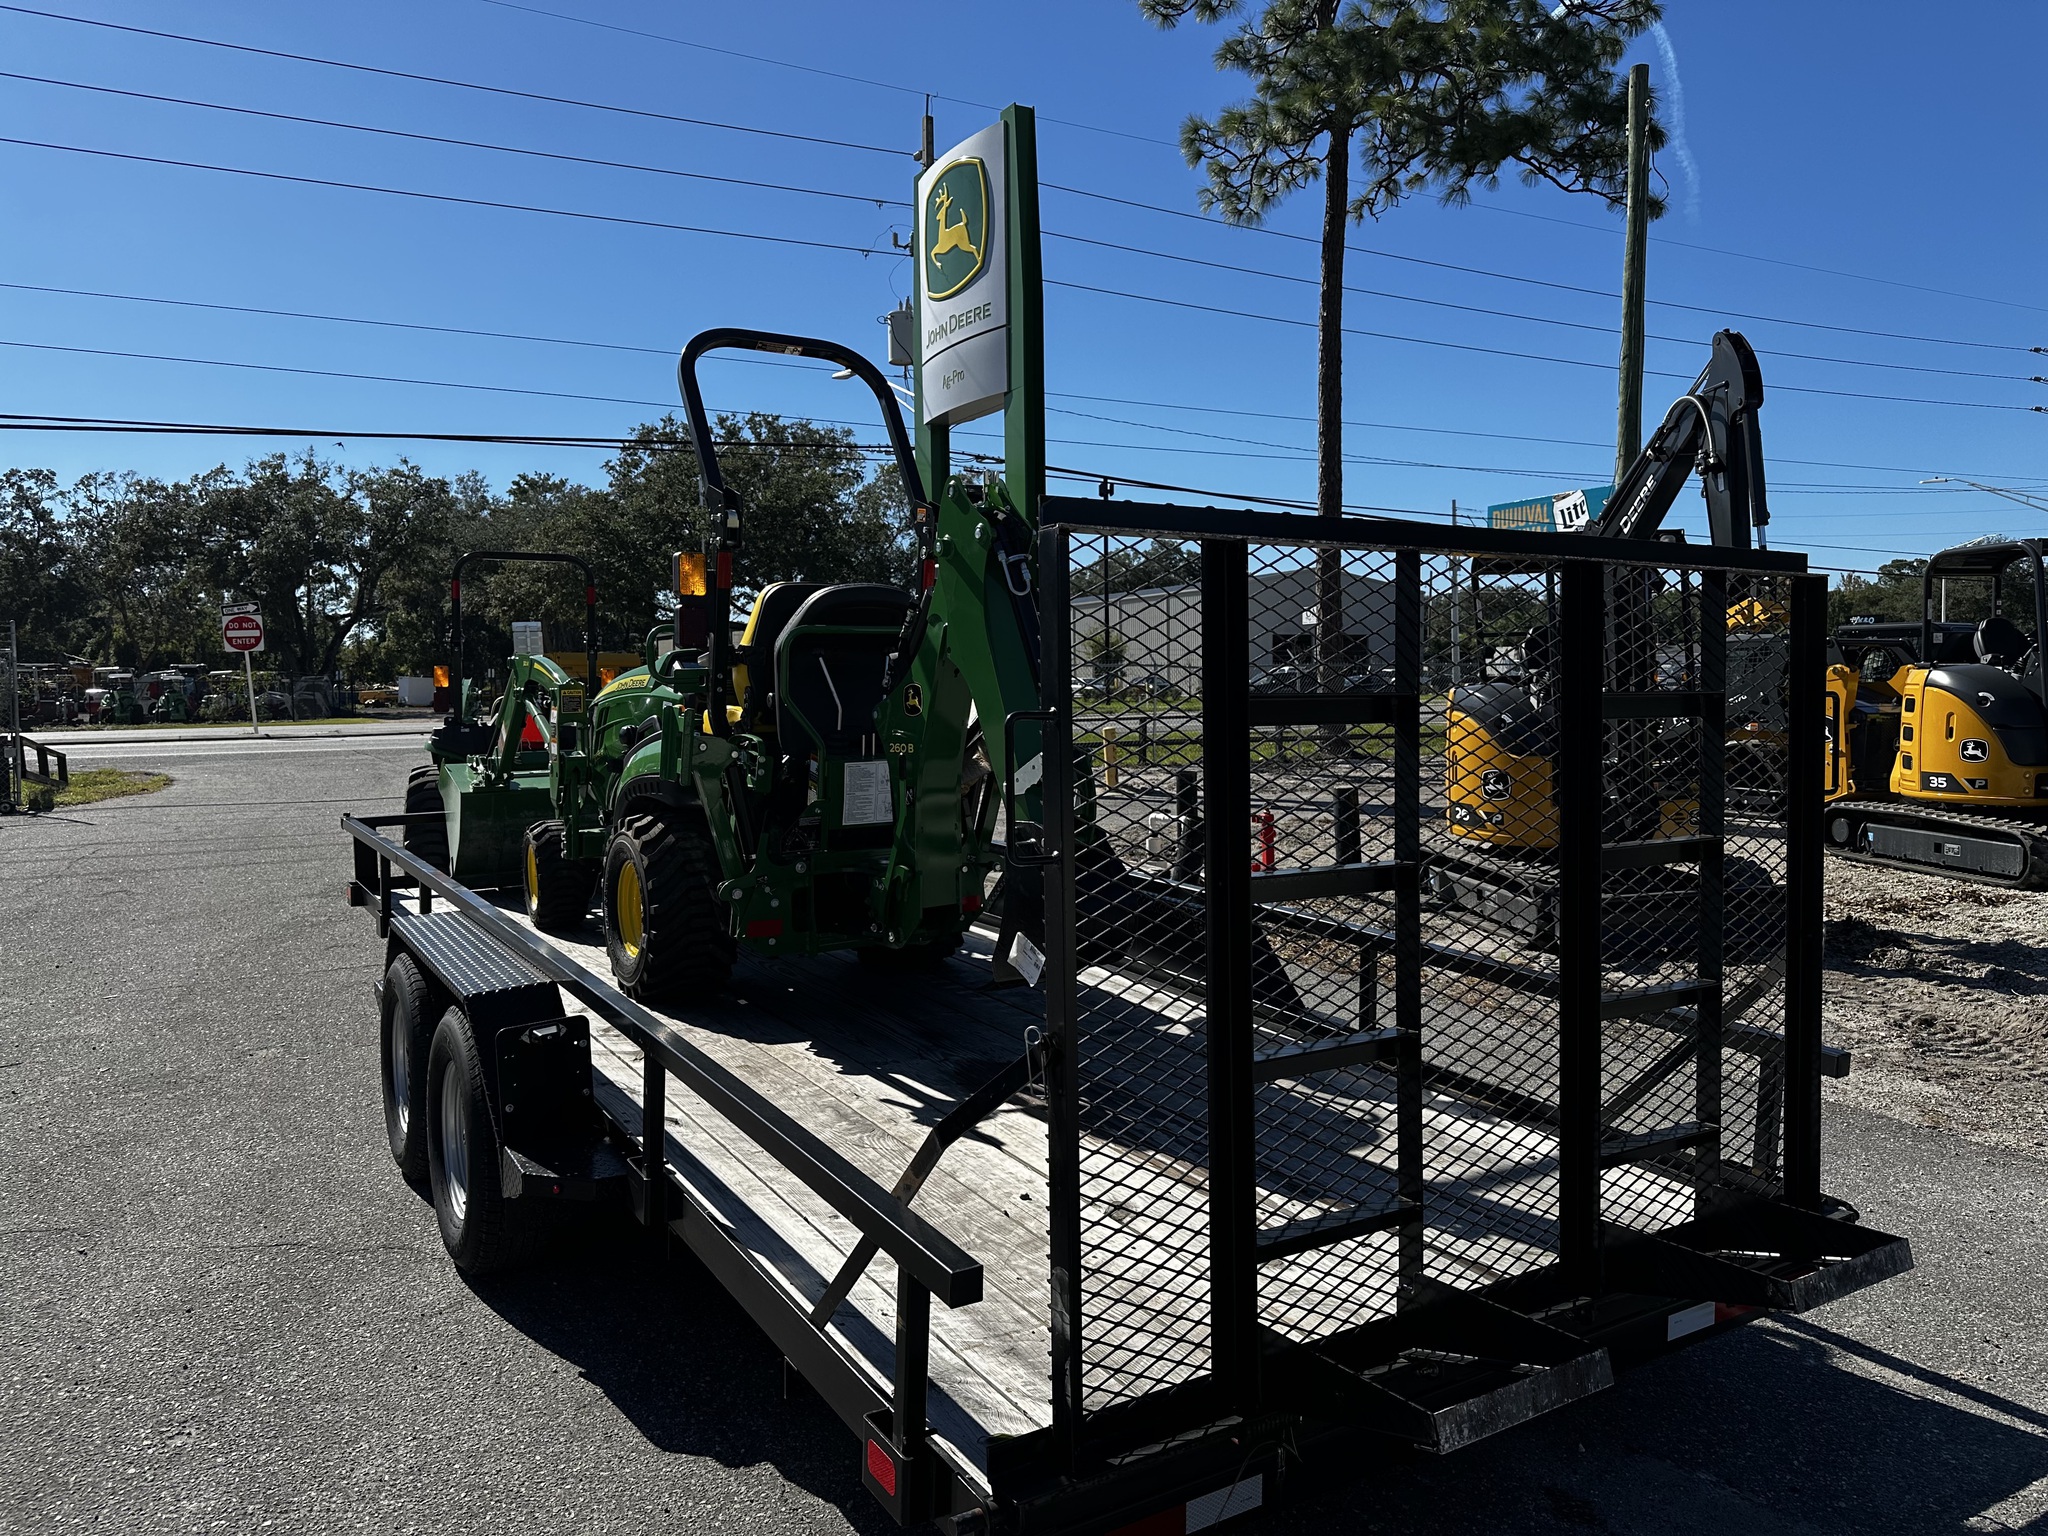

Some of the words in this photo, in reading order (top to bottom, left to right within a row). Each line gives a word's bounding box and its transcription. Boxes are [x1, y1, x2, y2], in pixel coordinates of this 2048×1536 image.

[926, 321, 948, 350] JOHN
[948, 301, 992, 335] DEERE
[942, 369, 965, 390] Ag-Pro
[1558, 498, 1587, 530] Lite
[1619, 473, 1657, 535] DEERE
[1492, 503, 1550, 529] DUUUVAL
[242, 621, 257, 629] NOT
[232, 637, 256, 645] ENTER
[615, 681, 630, 691] JOHN
[629, 678, 646, 689] DEERE
[1929, 776, 1948, 788] 35
[1974, 779, 1986, 788] P
